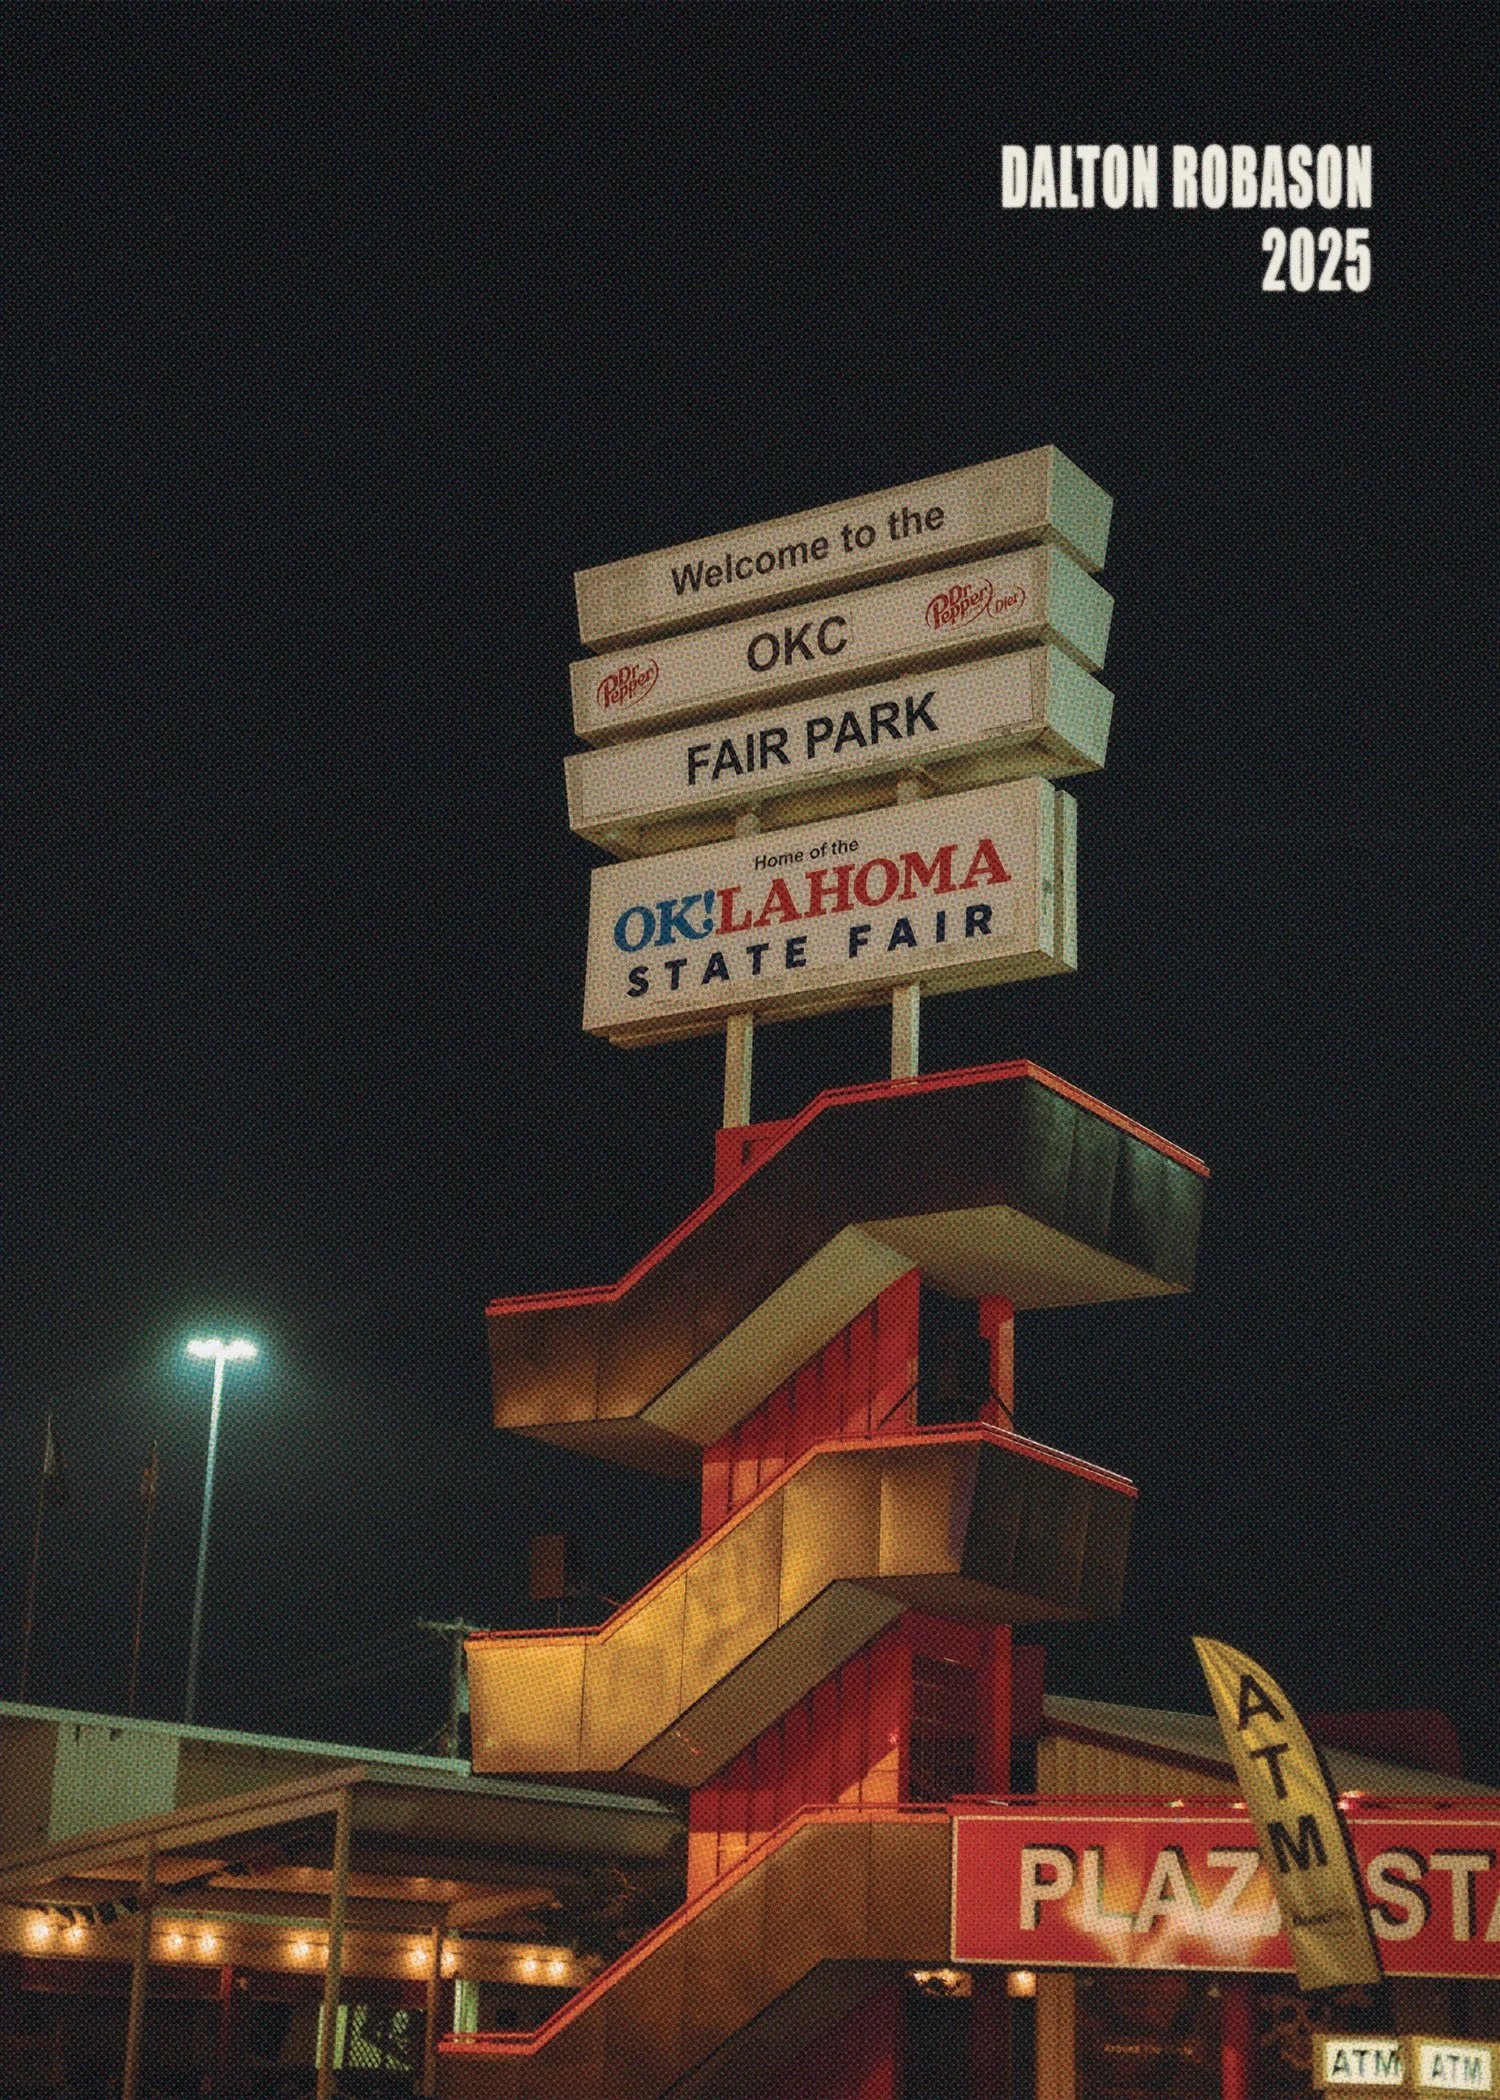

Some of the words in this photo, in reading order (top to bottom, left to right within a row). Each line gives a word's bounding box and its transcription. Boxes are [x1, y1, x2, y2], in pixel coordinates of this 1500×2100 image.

[671, 535, 829, 596] Welcome
[841, 518, 876, 552] to
[888, 505, 945, 542] the
[925, 586, 989, 630] Pepper
[949, 584, 972, 607] Dr
[995, 592, 1018, 614] Diet
[746, 615, 849, 673] OKC
[597, 667, 654, 708] Pepper
[618, 664, 640, 685] Dr
[687, 727, 789, 785] FAIR
[806, 691, 939, 759] PARK
[754, 849, 804, 871] Home
[809, 842, 827, 859] of
[830, 838, 860, 856] the
[613, 838, 1012, 953] OK!LAHOMA
[626, 935, 808, 998] STATE
[848, 903, 995, 959] FAIR
[1237, 1674, 1328, 1875] ATM
[1019, 1843, 1283, 1937] PLAZ
[1366, 1847, 1500, 1942] ST
[1331, 2048, 1401, 2078] ATM
[1431, 2053, 1482, 2084] ATM
